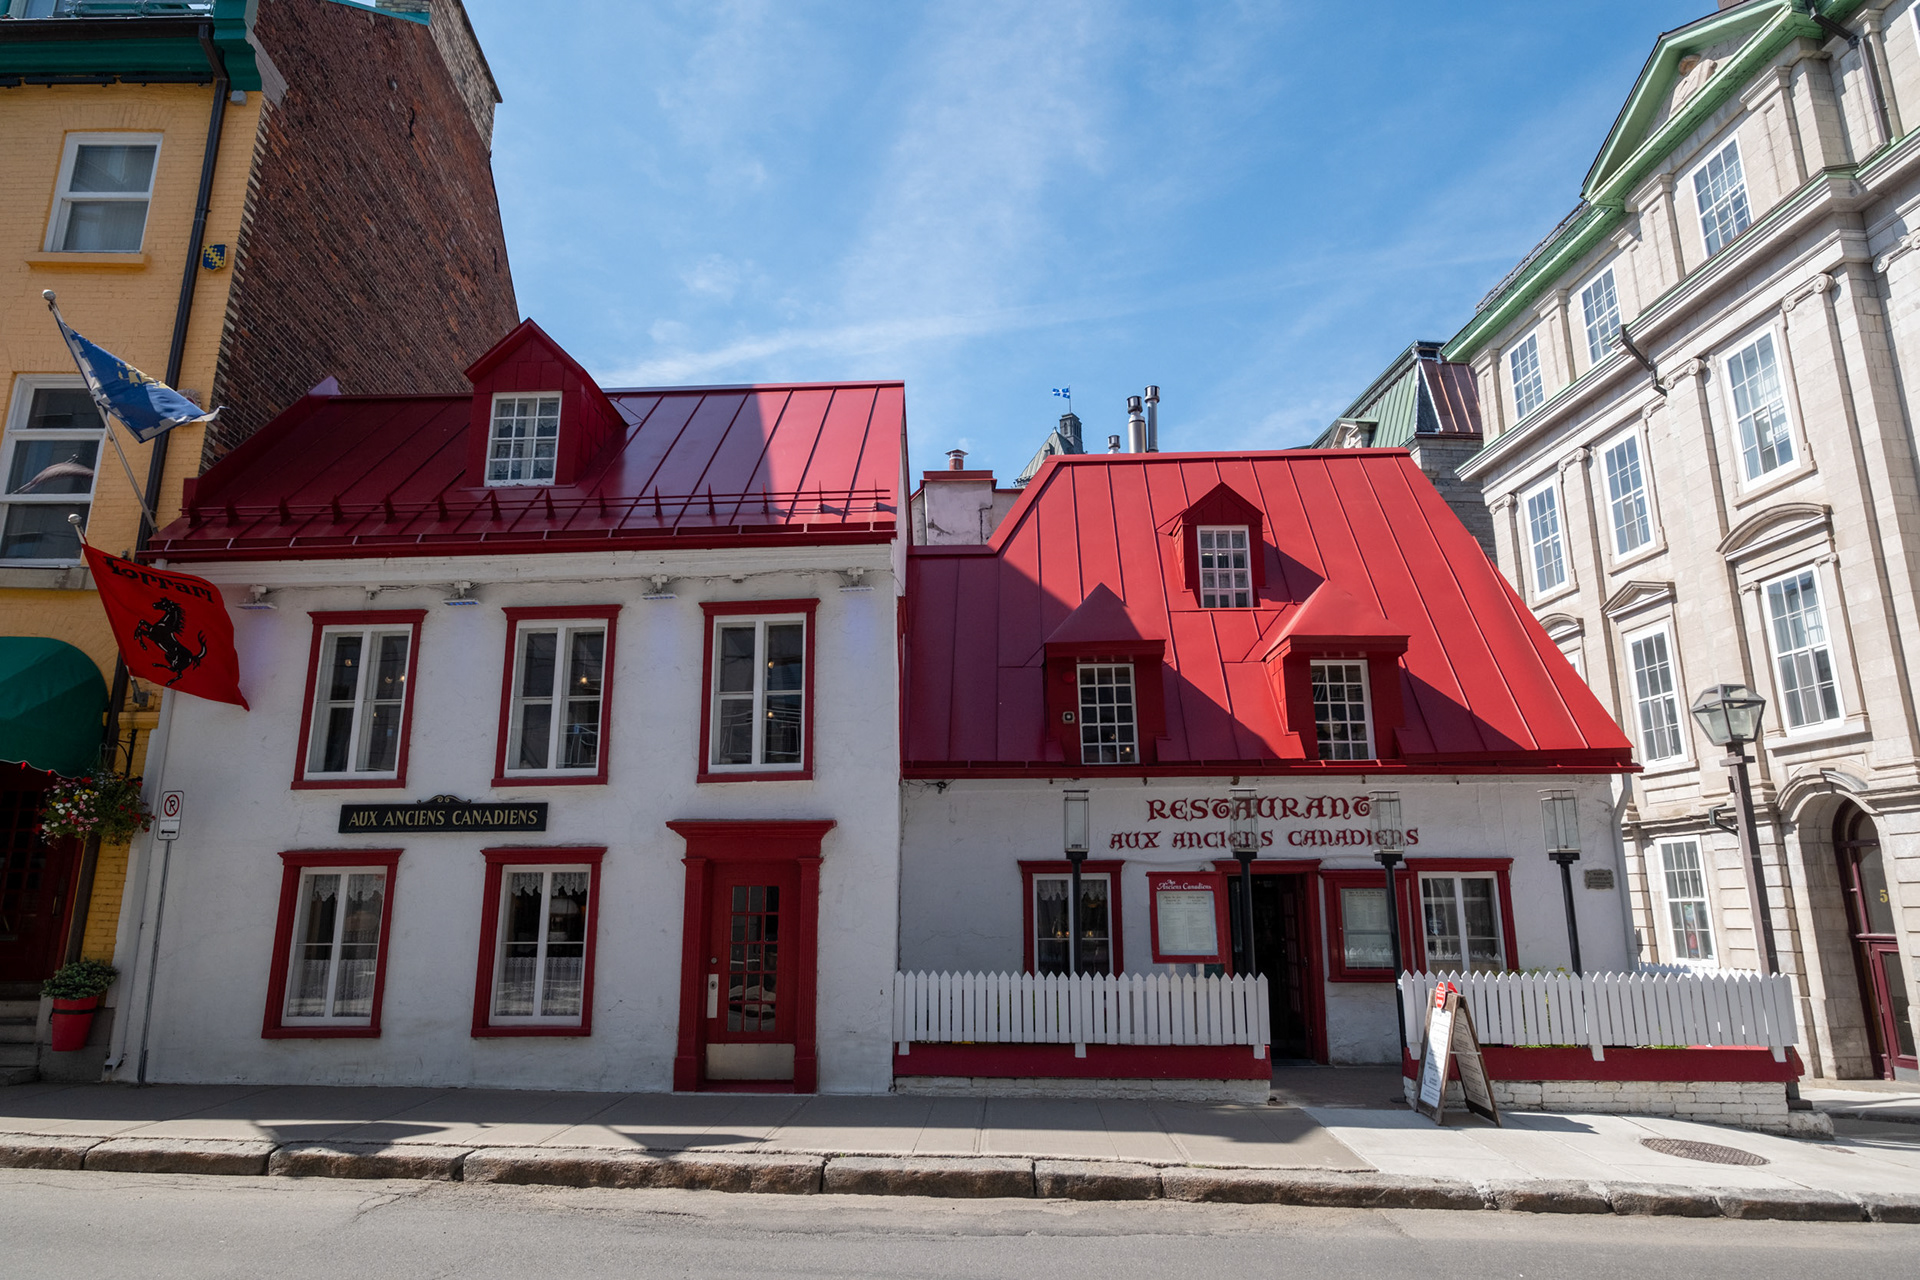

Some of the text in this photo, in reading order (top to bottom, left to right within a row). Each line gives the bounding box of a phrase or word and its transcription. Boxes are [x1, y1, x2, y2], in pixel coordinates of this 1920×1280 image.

[349, 809, 538, 826] AUX ANCIENS CANADIENS
[1146, 796, 1372, 822] RESTAURANT
[1109, 828, 1419, 849] AUX ANCIENS CANADIENS
[1182, 882, 1212, 890] Canadiens
[1880, 889, 1888, 903] 5
